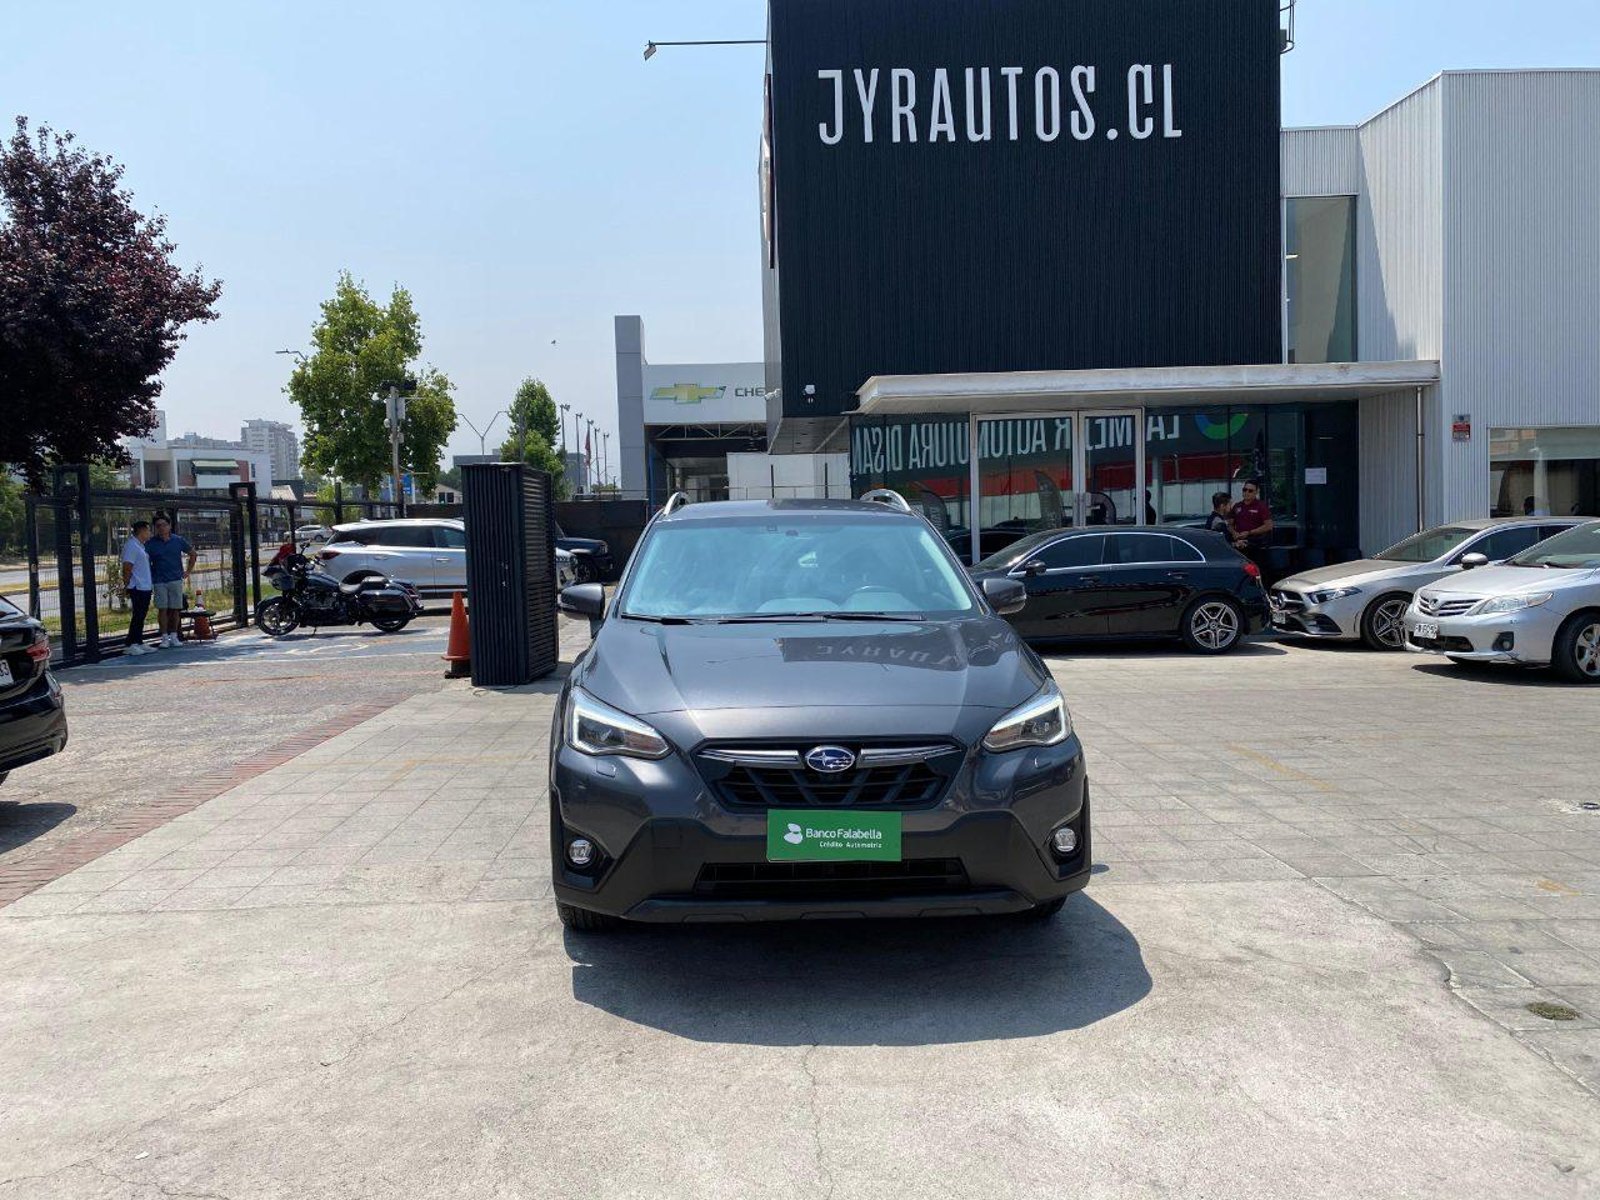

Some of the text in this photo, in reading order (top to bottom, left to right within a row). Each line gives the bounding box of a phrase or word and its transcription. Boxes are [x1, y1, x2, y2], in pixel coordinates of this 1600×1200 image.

[818, 63, 1182, 145] JYRAUTOS.CL
[805, 828, 882, 840] Banco Falabella
